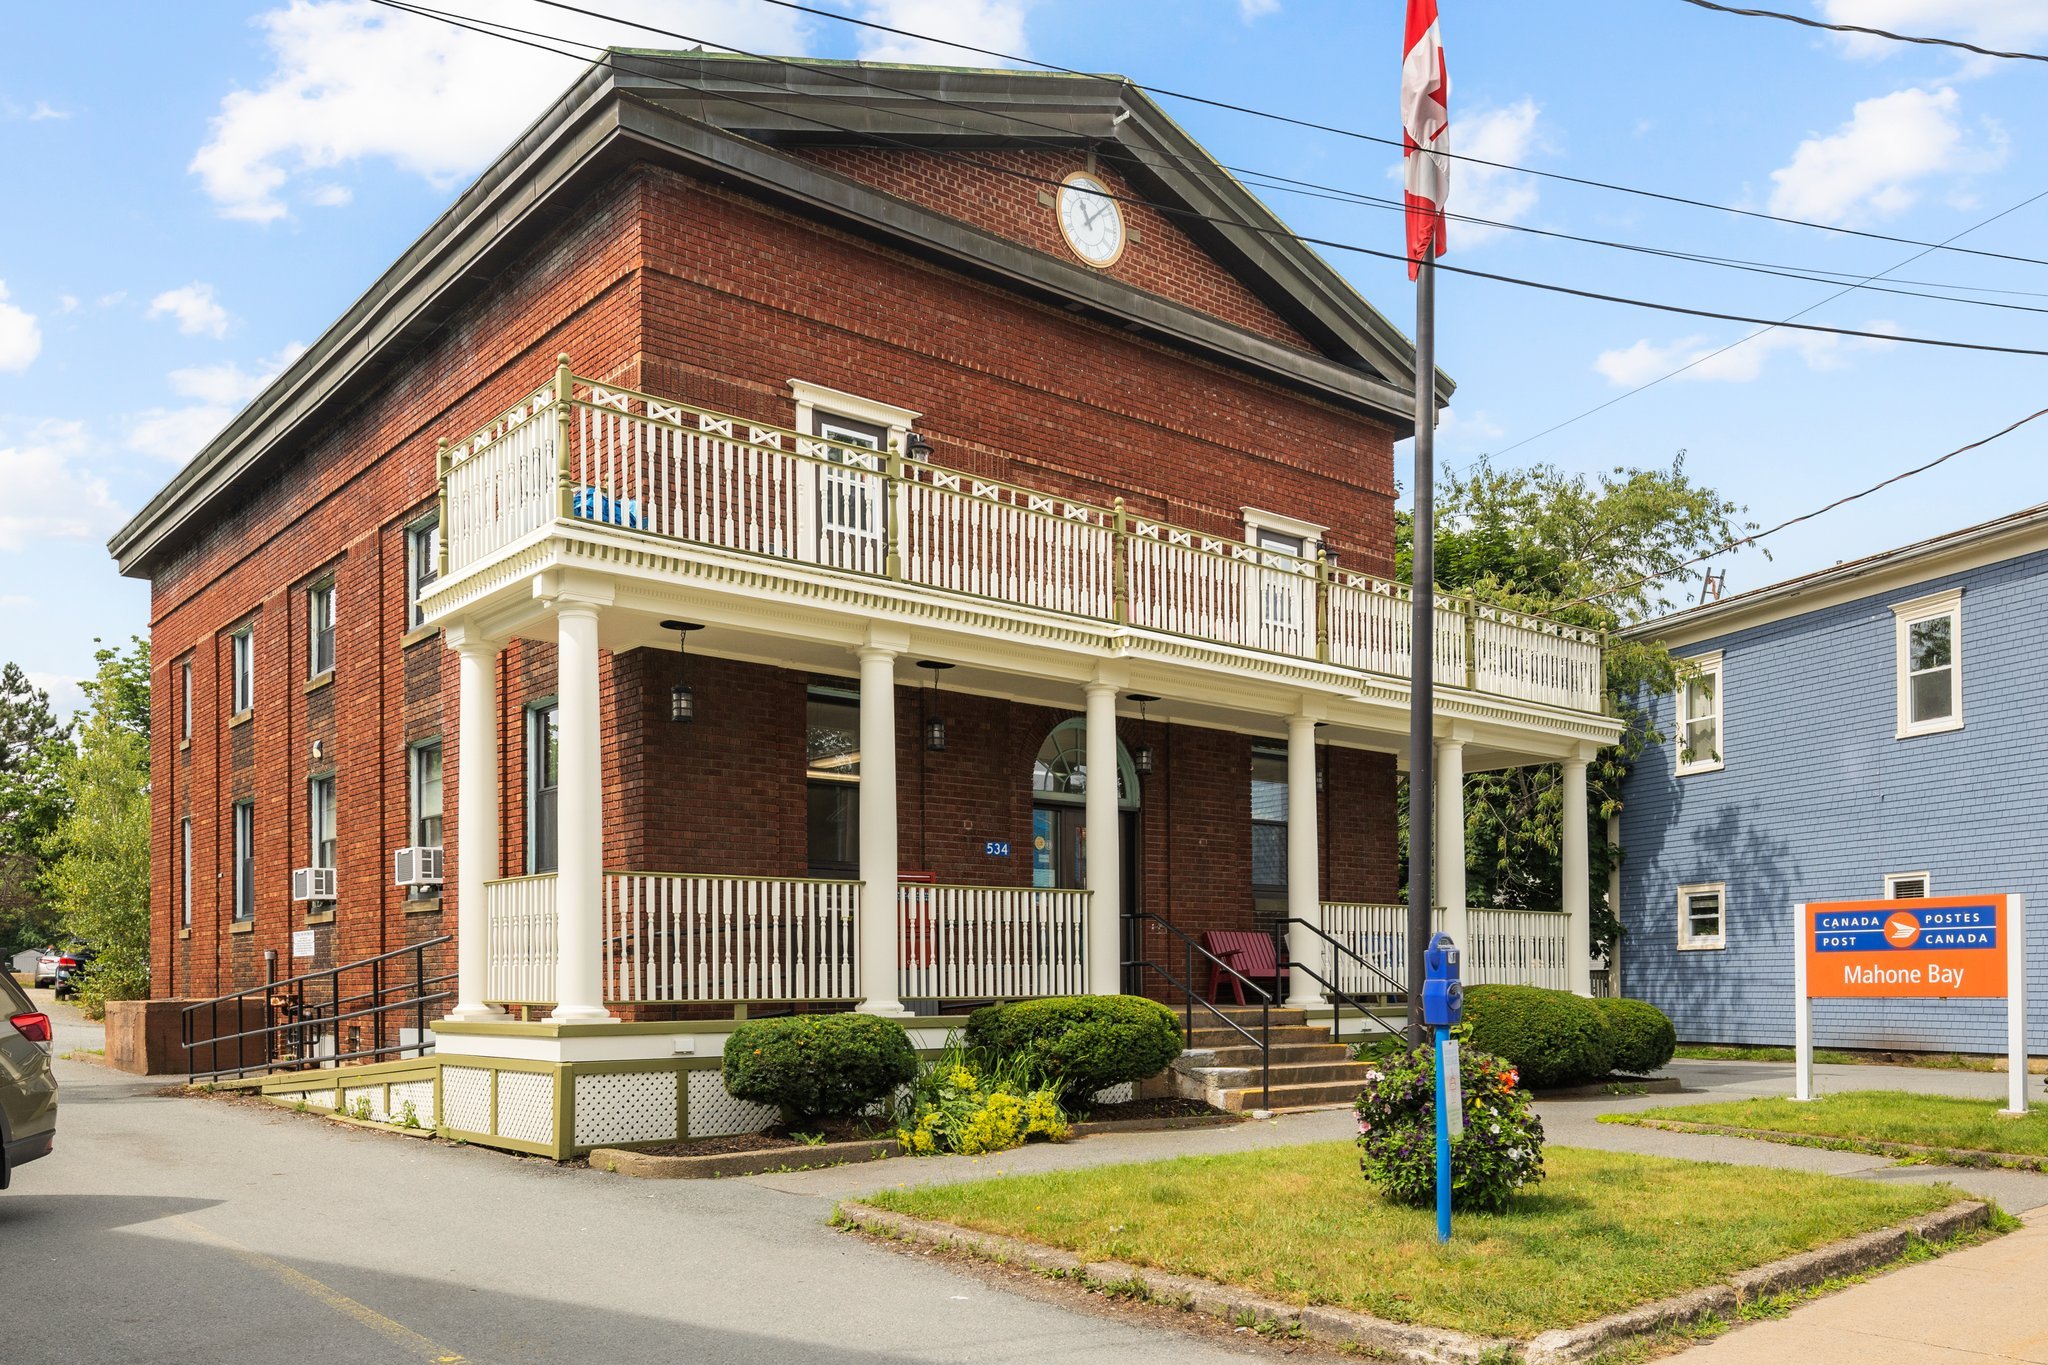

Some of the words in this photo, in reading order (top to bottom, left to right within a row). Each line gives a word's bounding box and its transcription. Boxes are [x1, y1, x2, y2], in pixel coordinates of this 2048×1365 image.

[986, 842, 1008, 855] 534
[1823, 916, 1879, 928] CANADA
[1925, 912, 1980, 924] POSTES
[1823, 936, 1857, 947] POST
[1925, 933, 1988, 945] CANADA
[1844, 964, 1921, 984] Mahone
[1928, 964, 1964, 989] Bay
